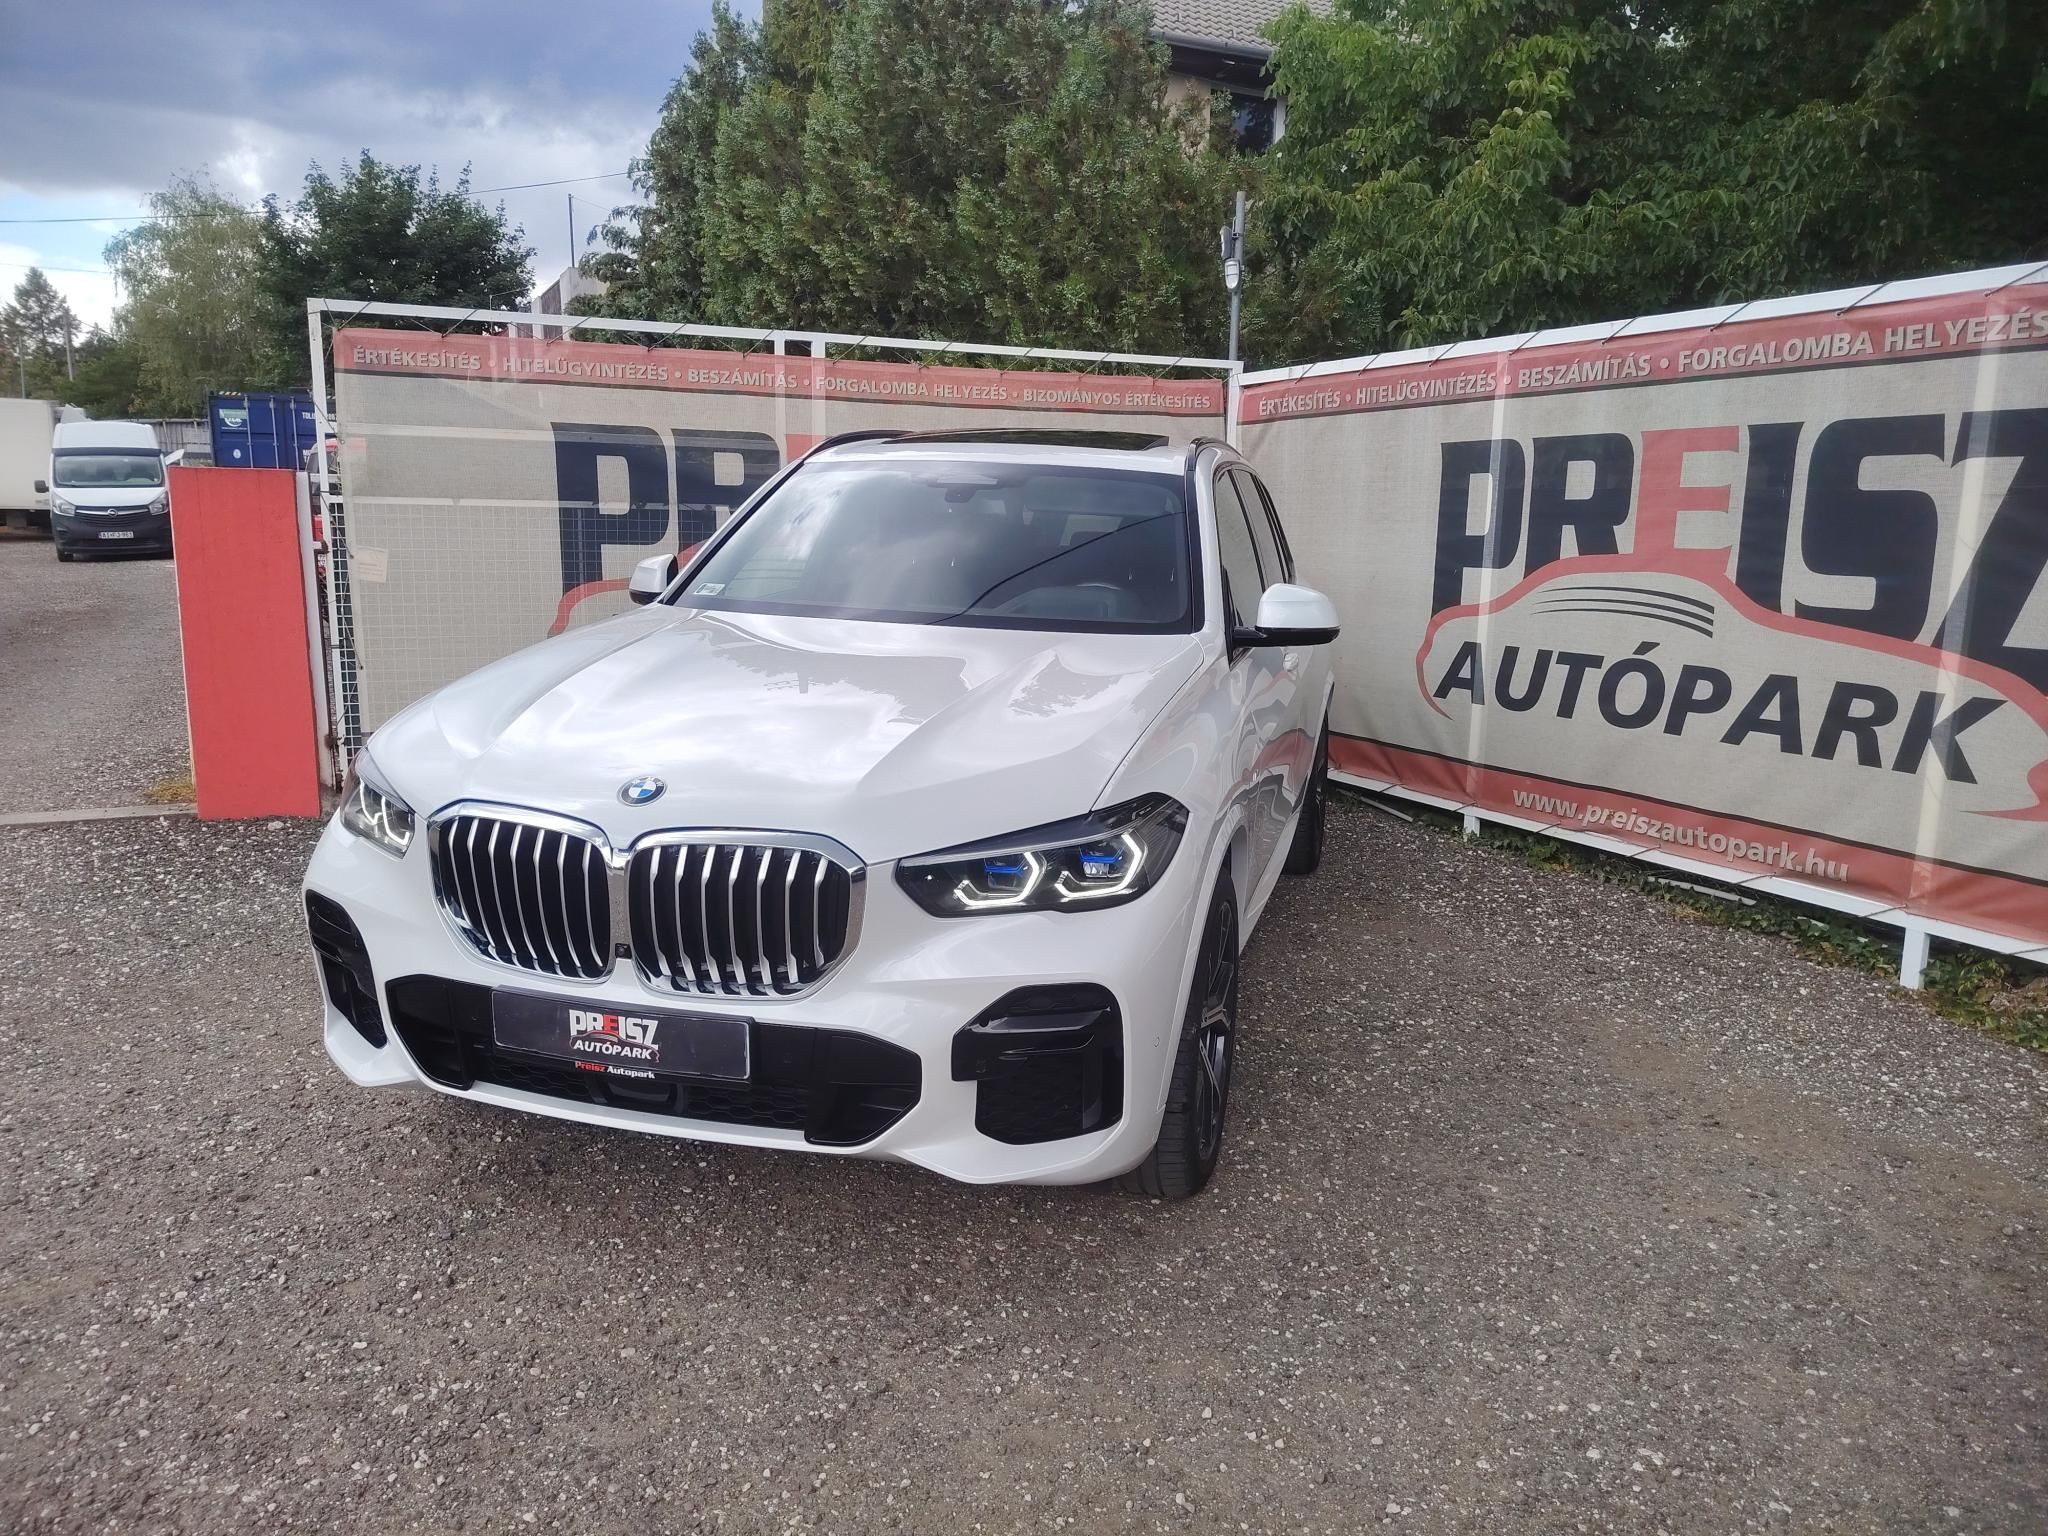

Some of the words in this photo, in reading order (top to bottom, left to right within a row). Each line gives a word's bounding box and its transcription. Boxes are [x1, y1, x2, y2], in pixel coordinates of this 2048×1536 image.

[353, 345, 482, 372] ÉRTÉKESÍTÉS
[503, 357, 669, 382] HITELÜGYINTÉZÉS
[687, 365, 798, 389] BESZÁMÍTÁS
[815, 375, 929, 398] FORGALOMBA
[933, 381, 1008, 401] HELYEZÉS
[1023, 386, 1121, 406] BIZOMÁNYOS
[1124, 390, 1211, 410] ÉRTÉKESÍTÉS
[1258, 389, 1341, 417] ÉRTÉKESÍTÉS
[1355, 371, 1498, 406] HITELÜGYINTÉZÉS
[1518, 353, 1652, 389] BESZÁMÍTÁS
[1678, 329, 1874, 373] FORGALOMBA
[1884, 306, 2048, 353] HELYEZÉS
[1430, 408, 2048, 698] PREISZ
[1433, 641, 2007, 785] AUTÓPARK
[1513, 789, 1849, 883] www.preiszautopark.hu
[569, 1009, 659, 1050] PREISZ
[573, 1040, 652, 1060] AUTÓPARK
[575, 1061, 605, 1072] Preisz
[607, 1065, 655, 1079] Autopark
